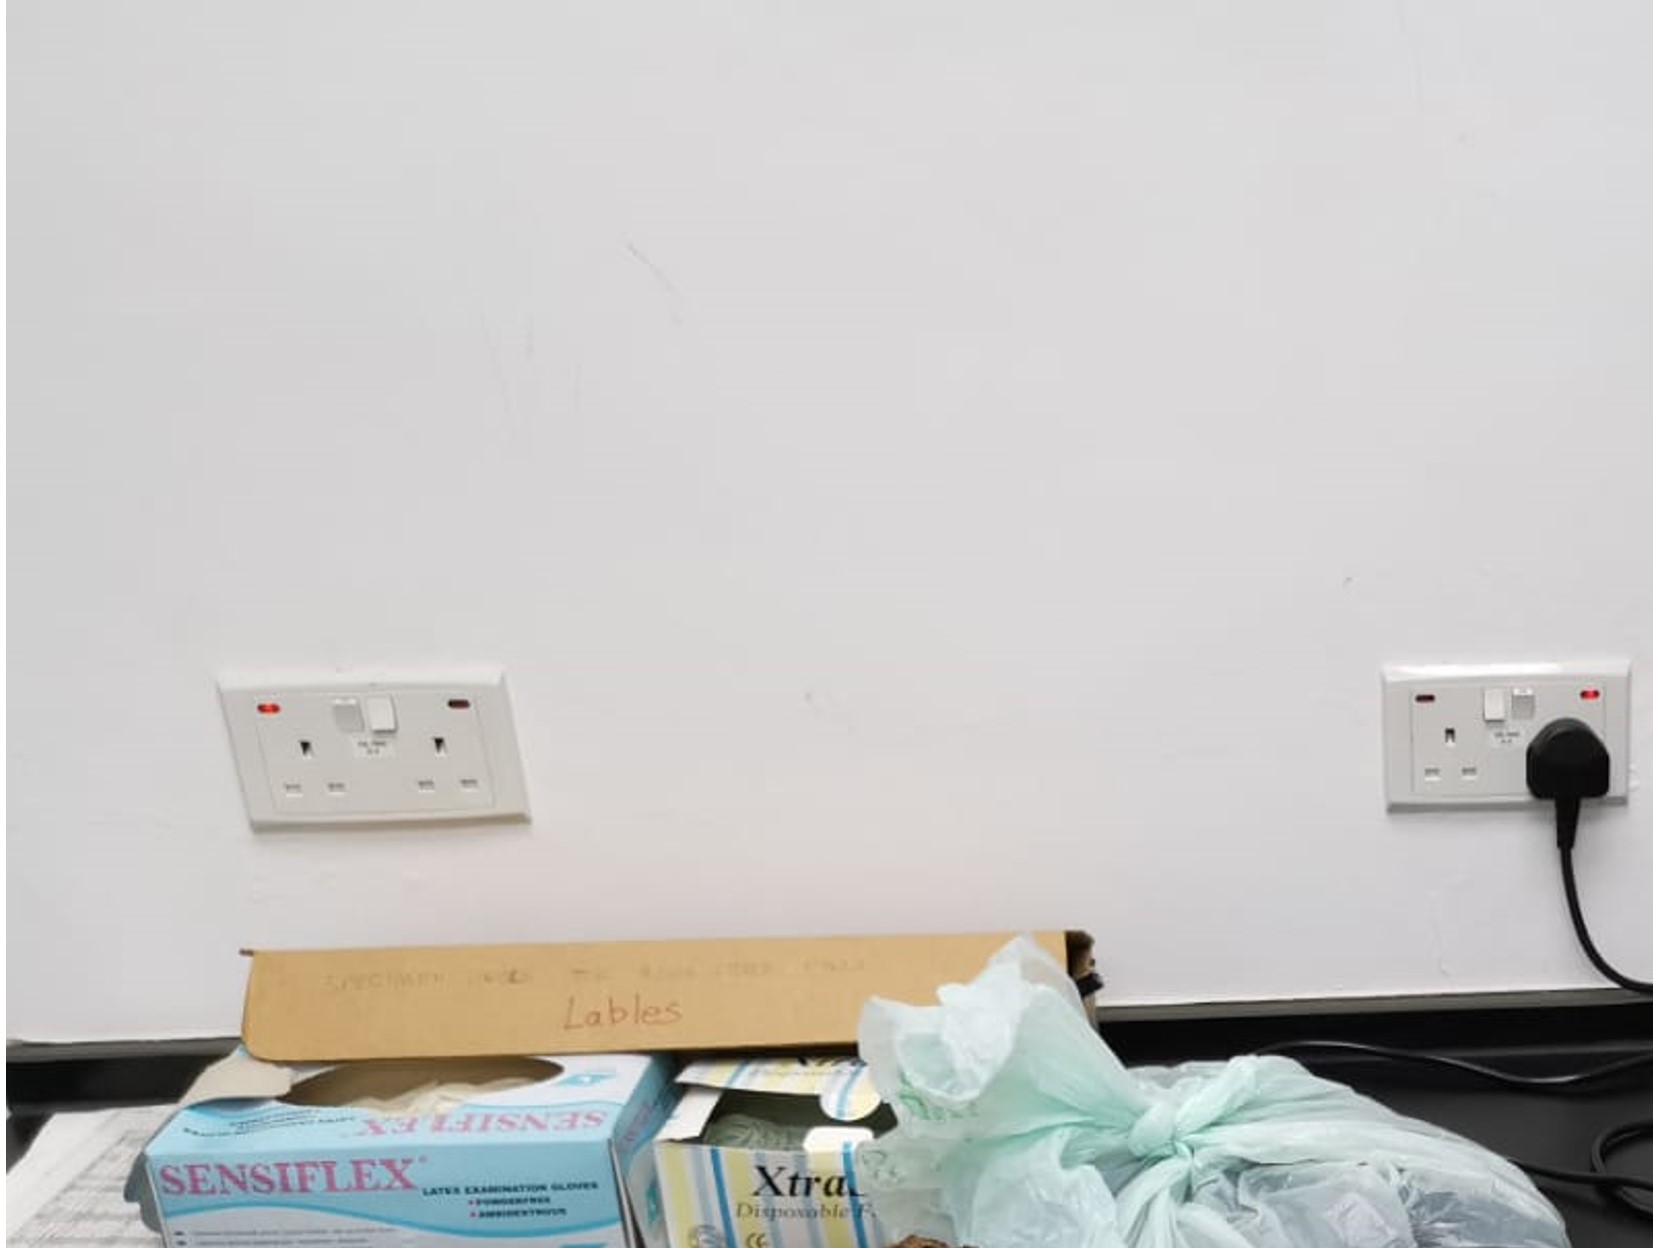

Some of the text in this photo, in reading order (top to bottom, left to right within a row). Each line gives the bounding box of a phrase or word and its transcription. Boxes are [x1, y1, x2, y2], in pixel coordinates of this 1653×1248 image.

[562, 993, 683, 1031] Lables
[159, 1158, 417, 1195] SENSIFLEX
[422, 1181, 599, 1197] LATEX EXAMINATION GLOVES
[752, 1164, 865, 1197] Xtra
[736, 1202, 849, 1221] Disposable
